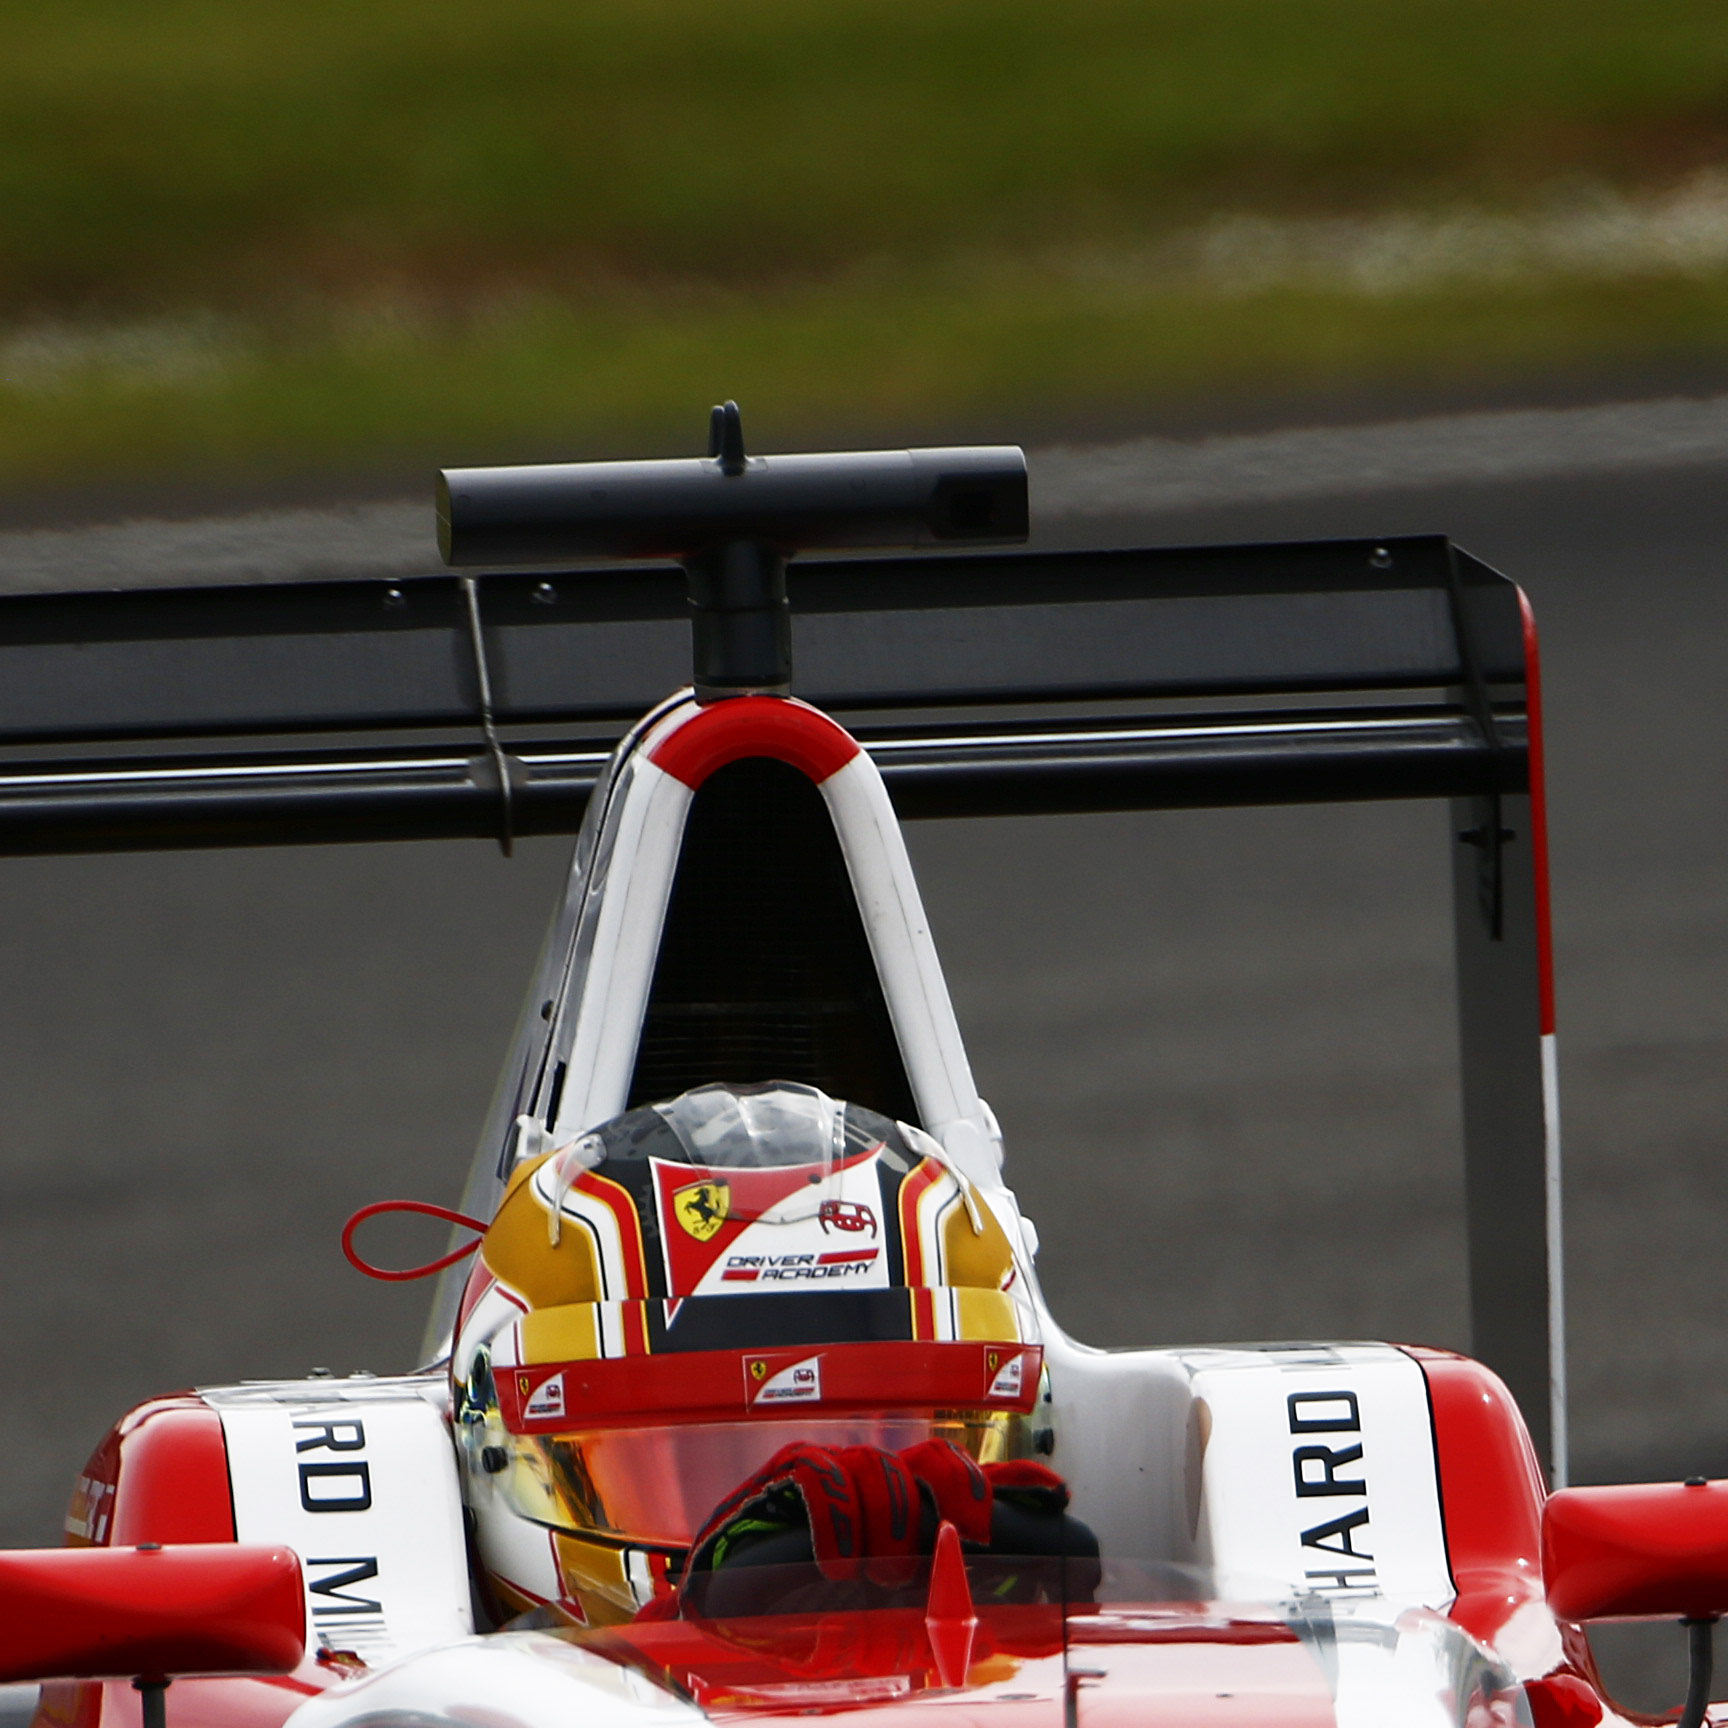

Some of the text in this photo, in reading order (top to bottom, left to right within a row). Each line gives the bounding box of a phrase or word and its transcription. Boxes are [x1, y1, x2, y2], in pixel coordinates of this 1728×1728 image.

[727, 1254, 815, 1268] DRIVER
[761, 1261, 875, 1281] ACADEMY
[1287, 1390, 1380, 1598] HARD
